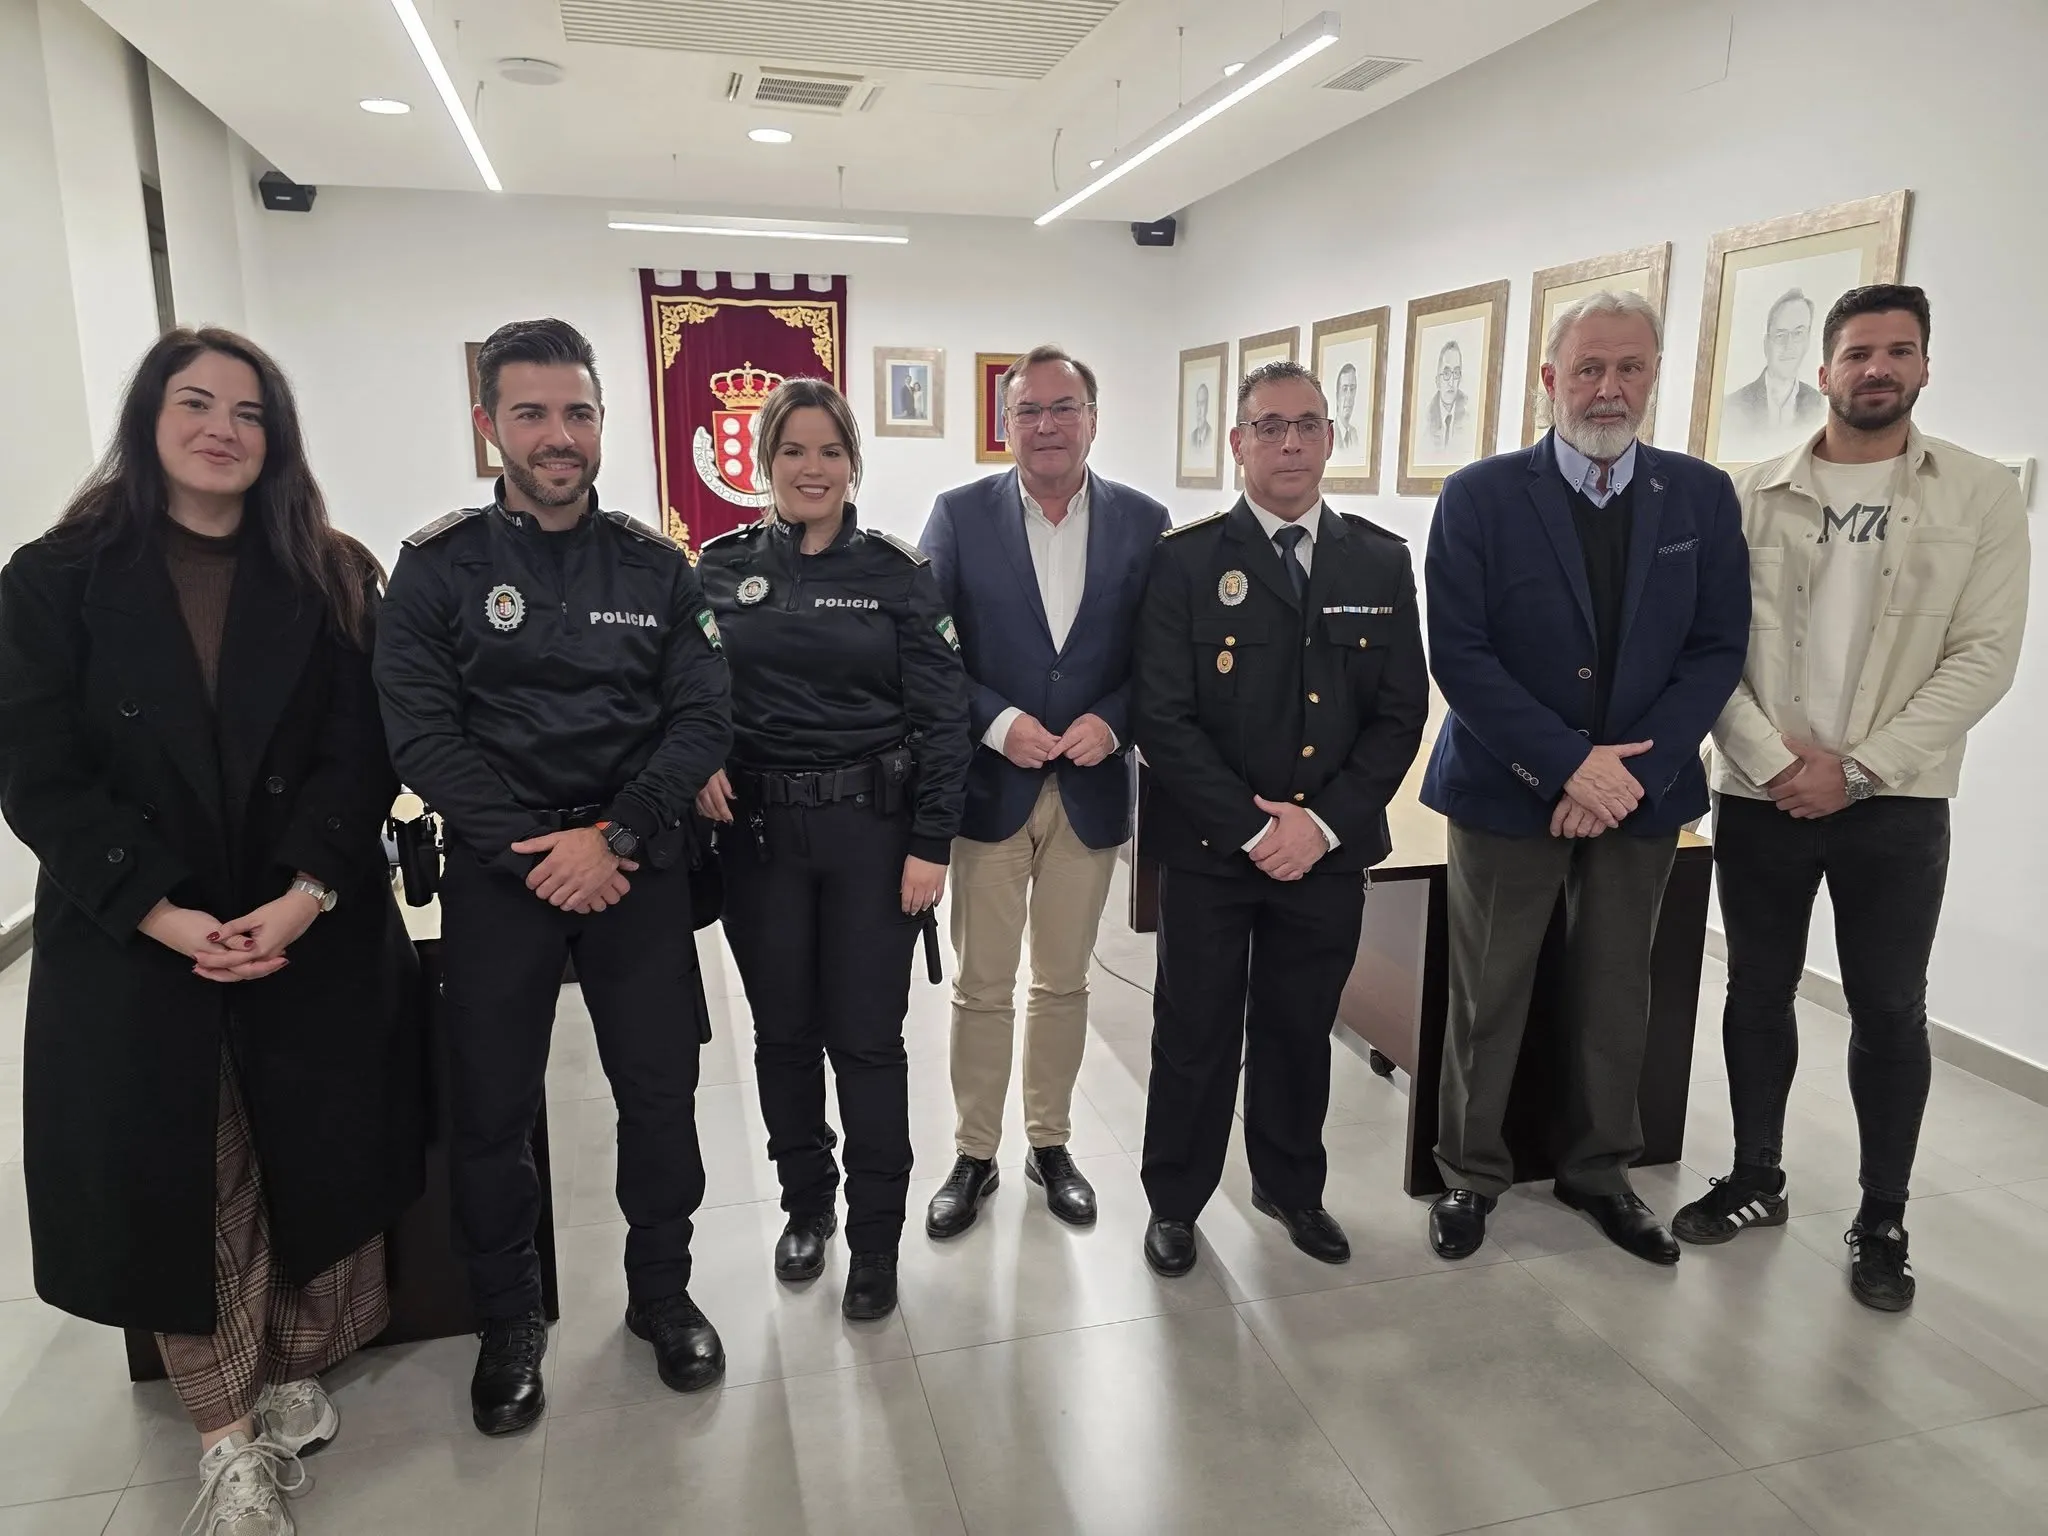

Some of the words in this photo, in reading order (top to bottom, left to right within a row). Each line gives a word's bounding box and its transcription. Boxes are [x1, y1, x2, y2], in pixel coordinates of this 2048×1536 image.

[1816, 502, 1892, 544] M7
[814, 598, 879, 610] POLICIA
[589, 611, 658, 627] POLICIA
